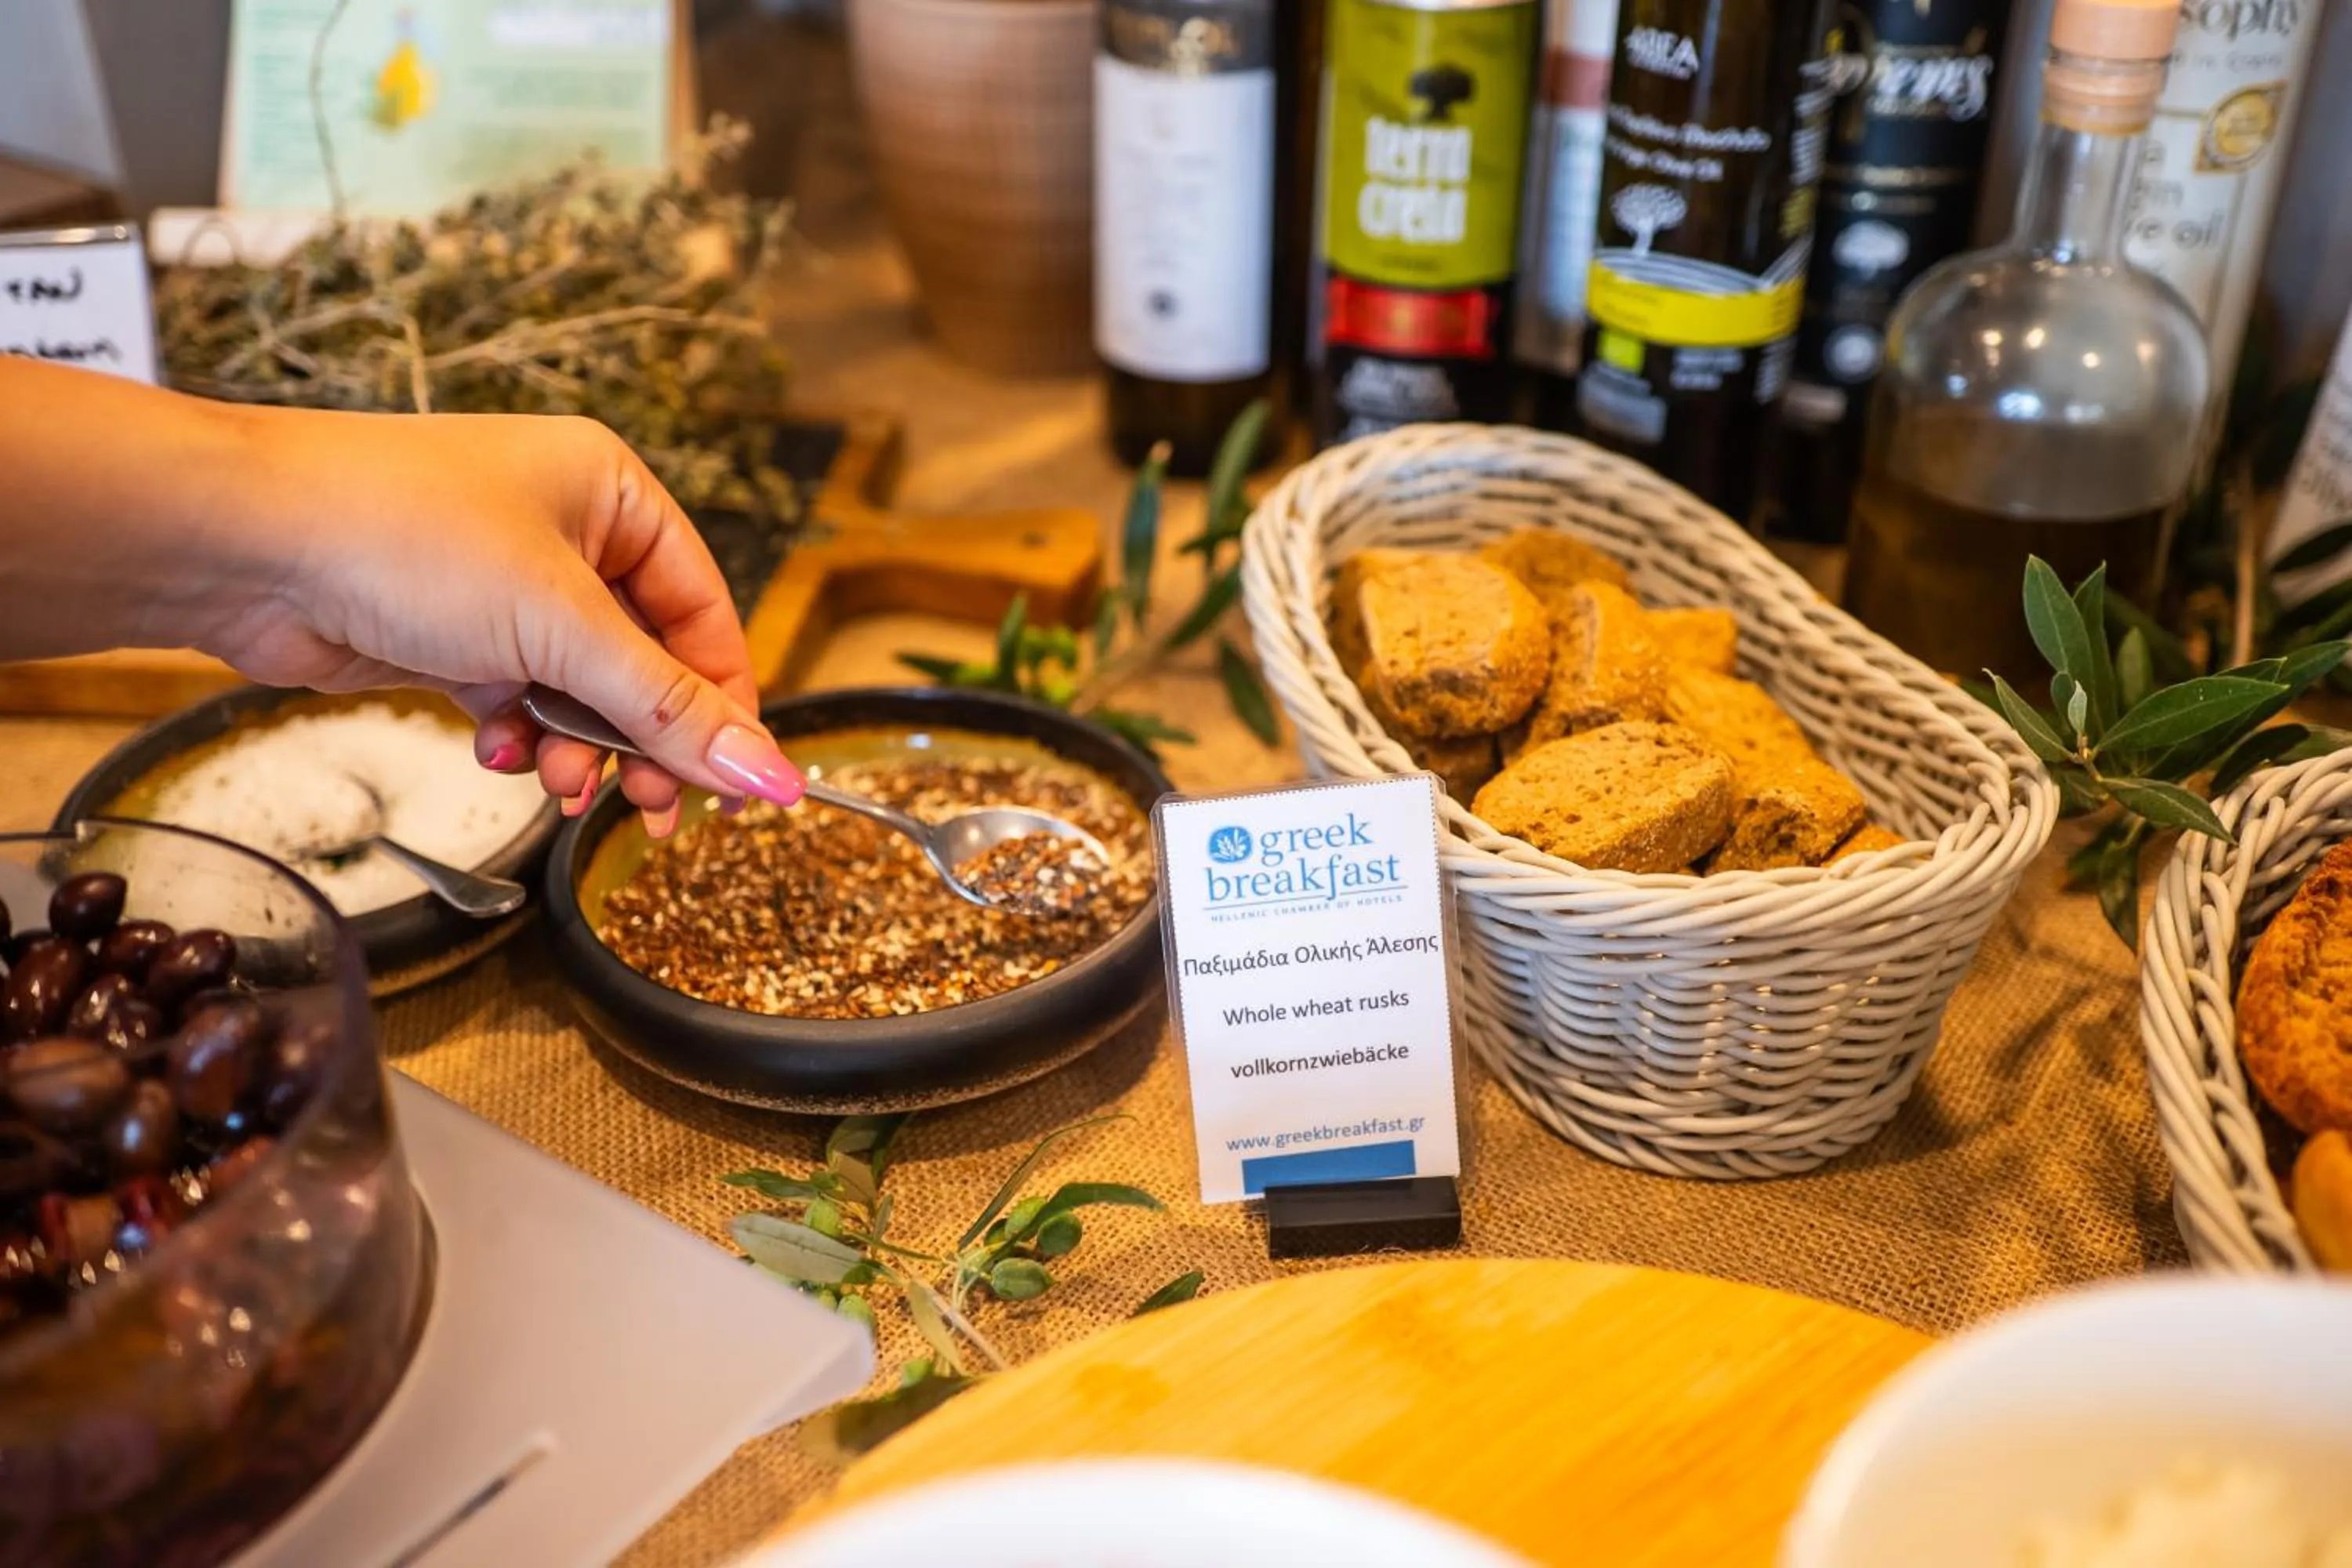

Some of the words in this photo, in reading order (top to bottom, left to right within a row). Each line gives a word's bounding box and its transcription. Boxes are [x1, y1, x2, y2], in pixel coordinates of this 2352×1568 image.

[1260, 812, 1374, 867] greek
[1203, 854, 1400, 901] breakfast
[1211, 909, 1267, 922] HELLENIC
[1274, 902, 1330, 916] CHAMBER
[1338, 900, 1350, 909] OF
[1357, 895, 1403, 906] HOTELS
[1183, 949, 1289, 976] Παξιμάδια
[1294, 940, 1363, 964] Ολικής
[1366, 935, 1439, 955] Άλεσης
[1222, 1003, 1287, 1026] Whole
[1292, 996, 1352, 1018] wheat
[1359, 990, 1410, 1011] rusks
[1231, 1044, 1410, 1078] vollkornzwiebäcke
[1226, 1116, 1425, 1151] www.greekbreakfast.gr
